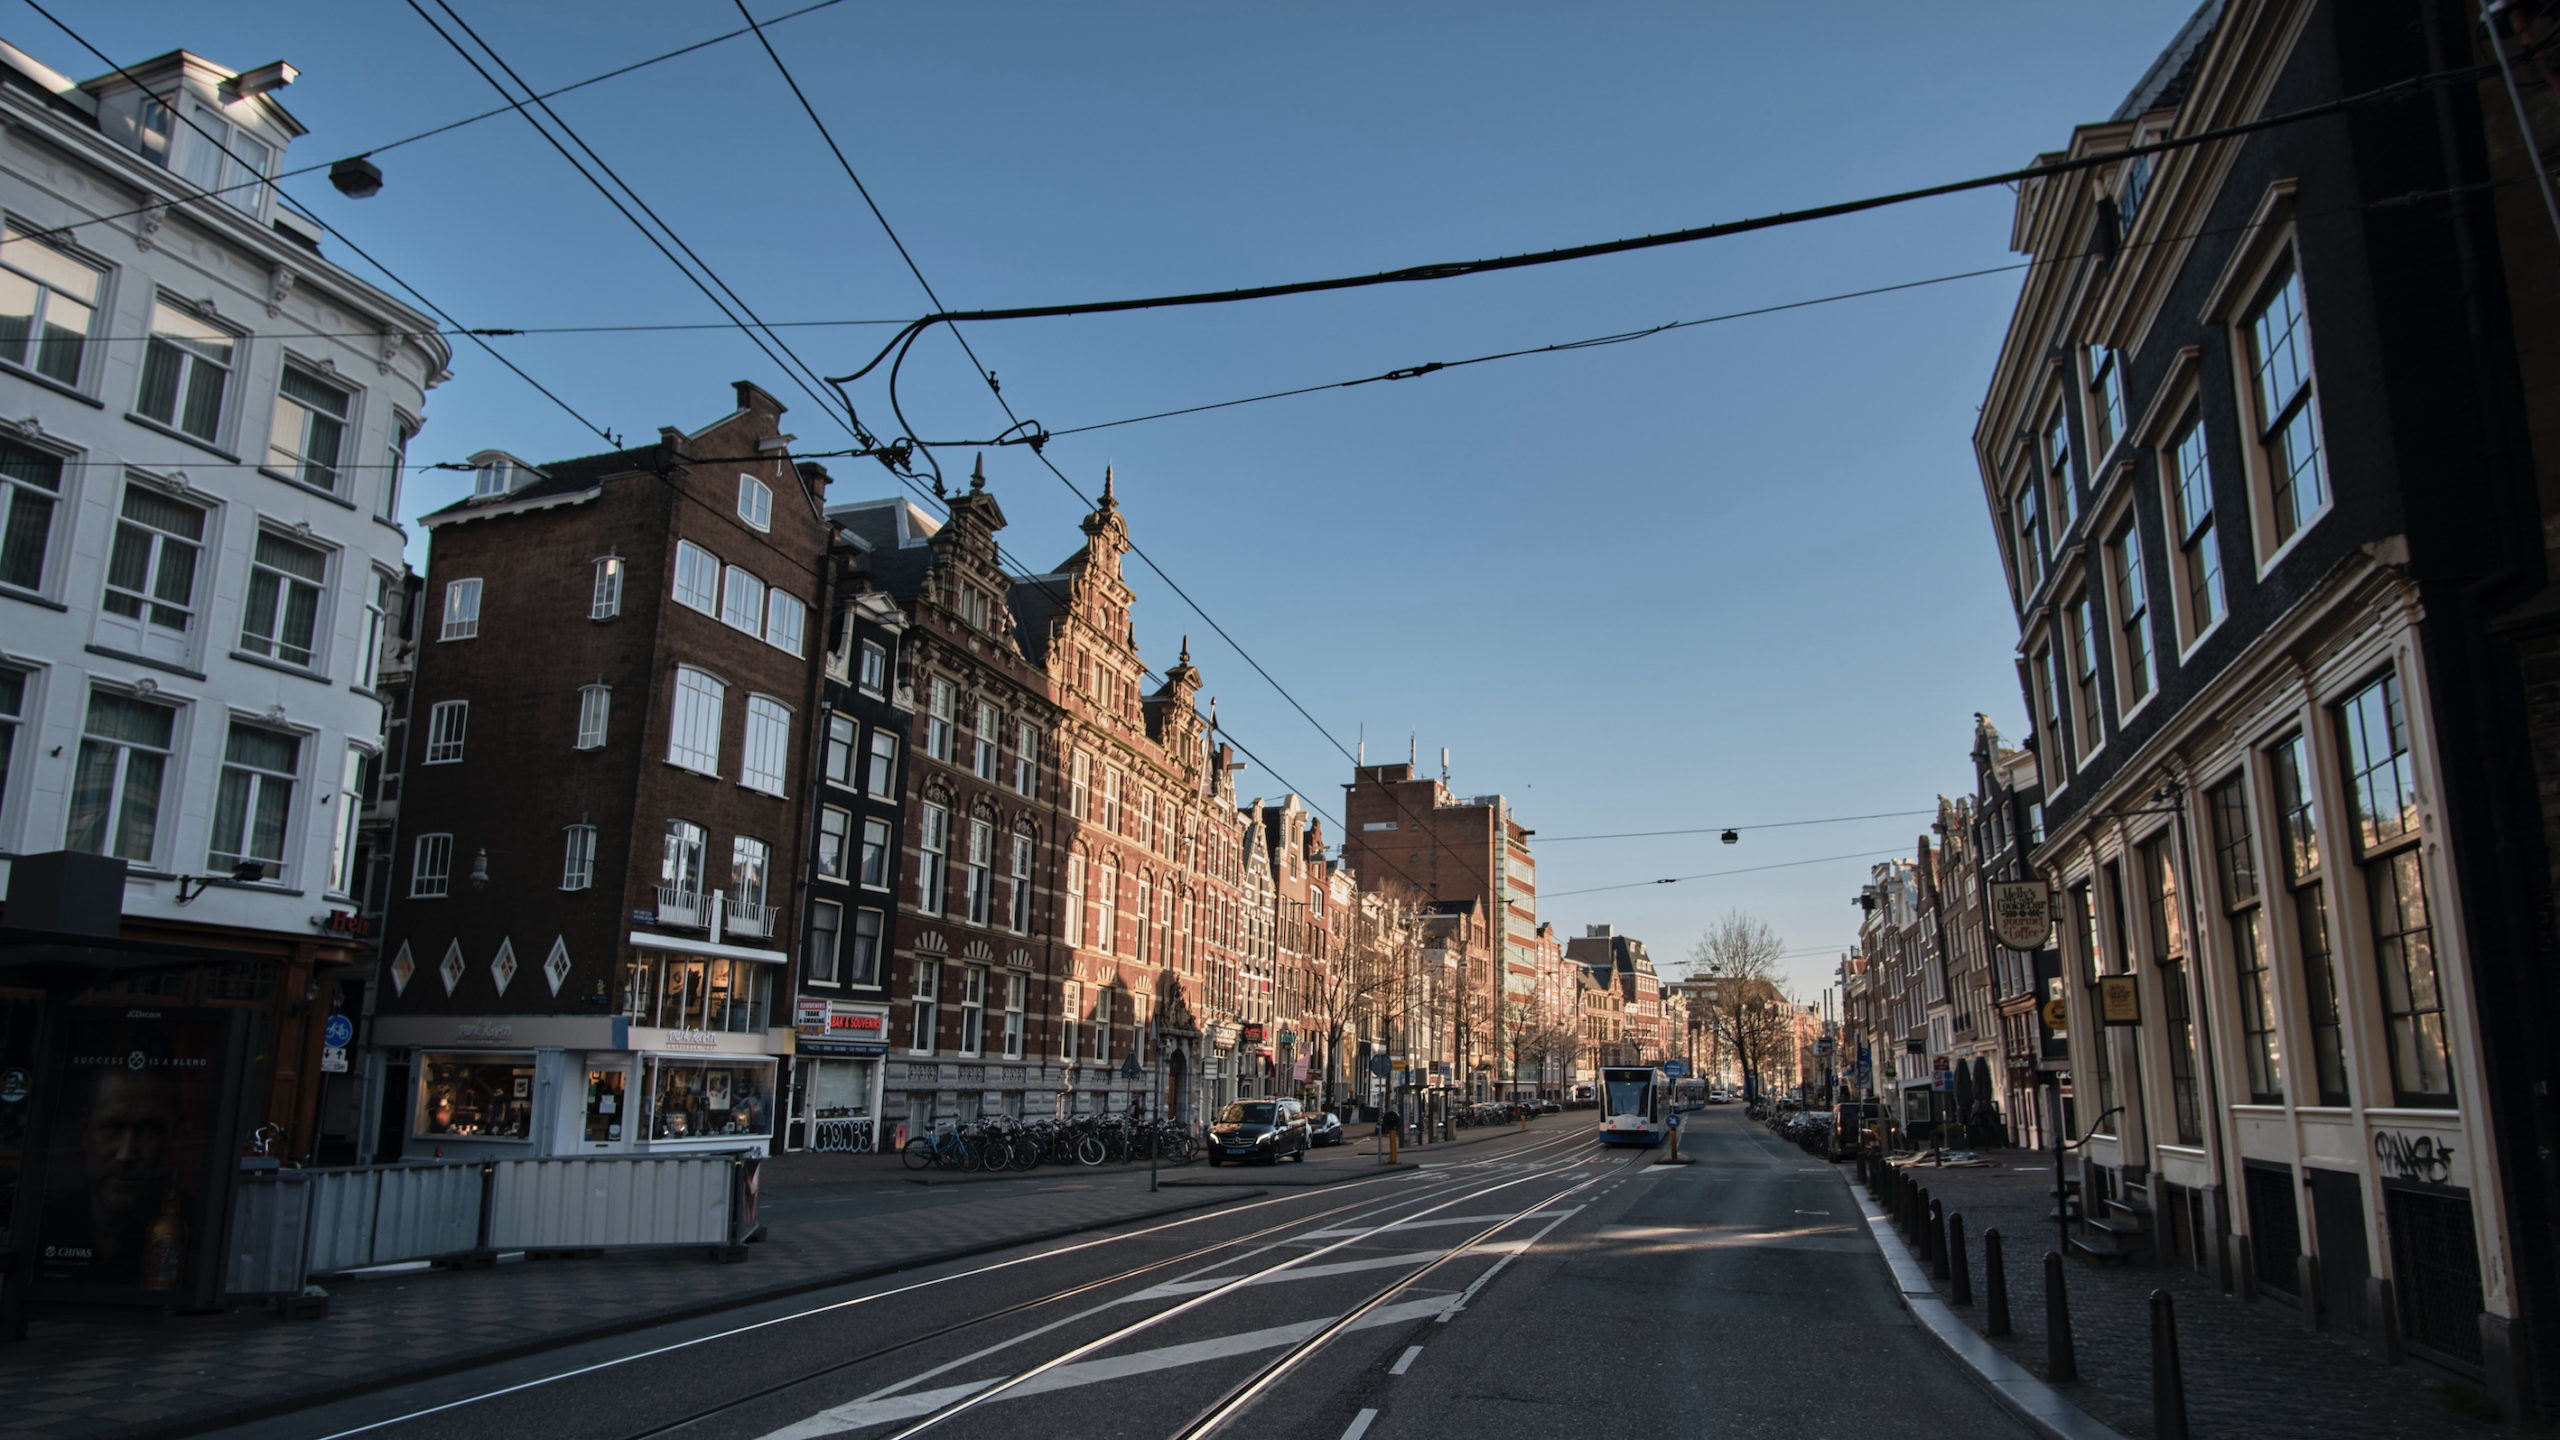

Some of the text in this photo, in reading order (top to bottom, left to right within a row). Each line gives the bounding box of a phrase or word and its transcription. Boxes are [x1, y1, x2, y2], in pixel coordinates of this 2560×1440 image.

[2003, 886, 2036, 901] Melly's
[2003, 916, 2044, 929] gourmet
[2009, 927, 2039, 940] Coffee
[851, 1016, 881, 1030] SOUVENIRS
[73, 1056, 208, 1067] SUCCESS IS A BLEND
[57, 1247, 93, 1257] CHIVAS
